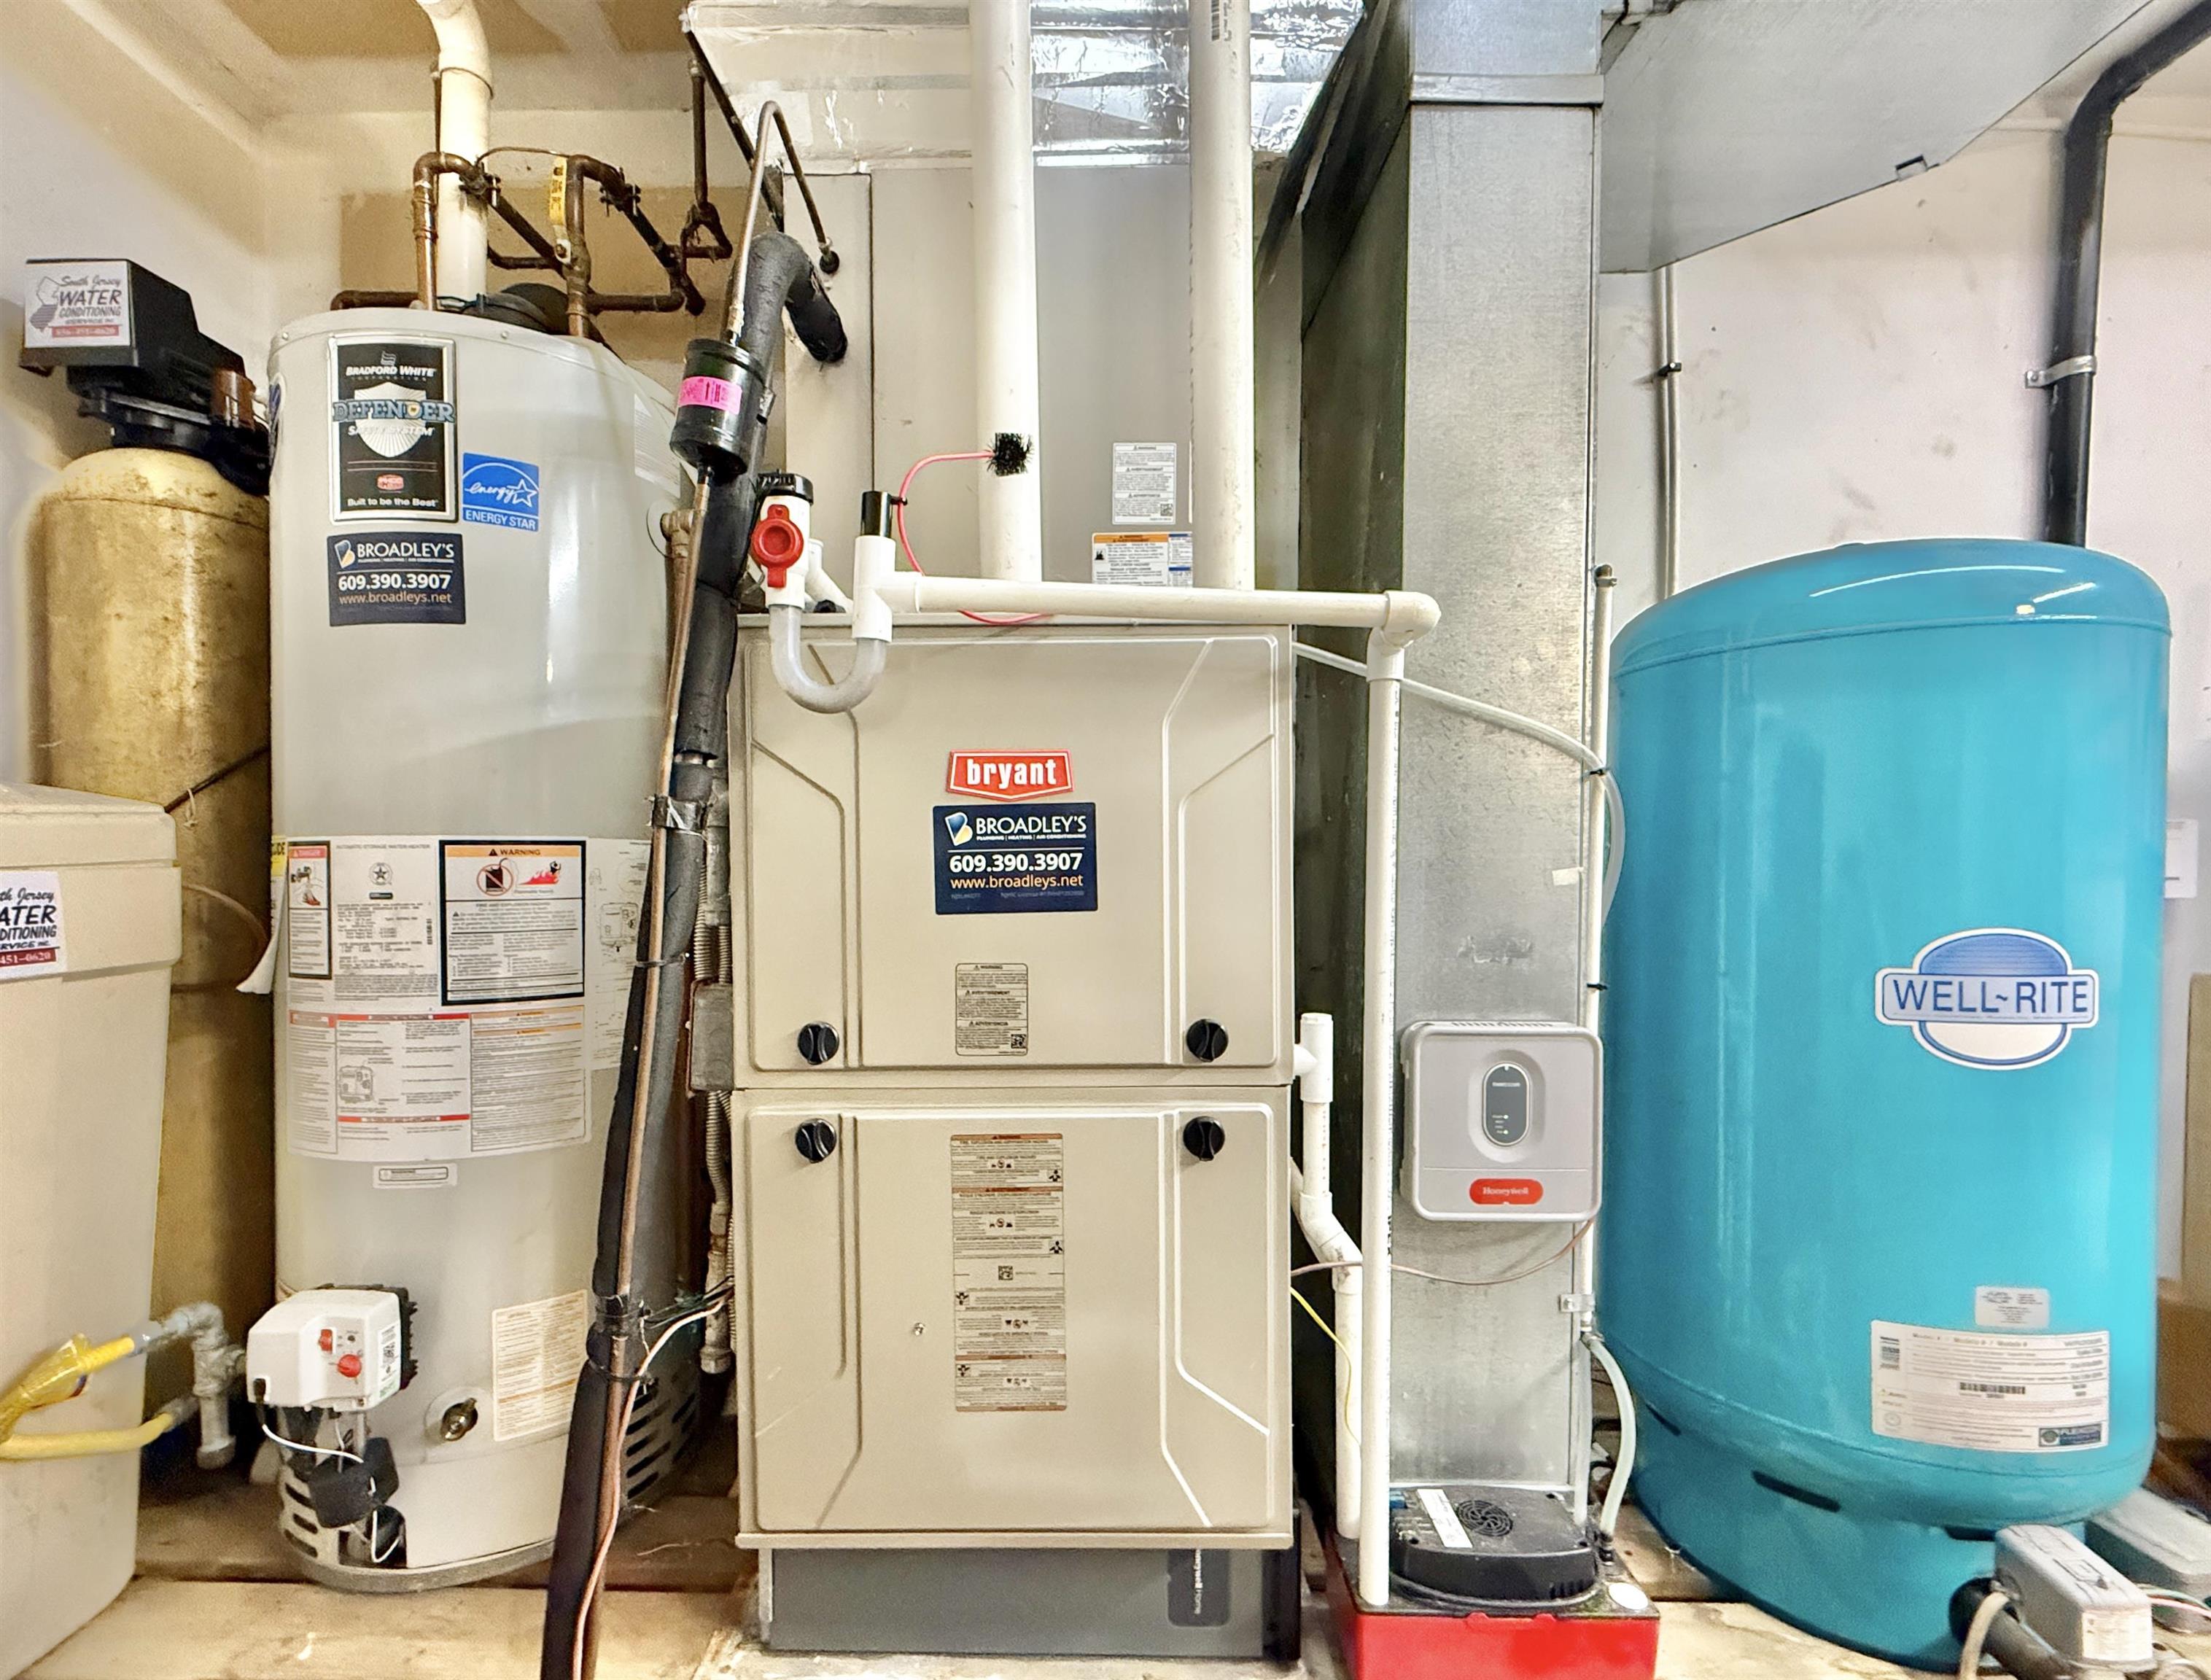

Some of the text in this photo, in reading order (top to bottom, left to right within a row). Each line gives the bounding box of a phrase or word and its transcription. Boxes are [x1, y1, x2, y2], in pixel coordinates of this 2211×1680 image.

[59, 289, 123, 306] WATER
[59, 306, 122, 319] CONDITIONING
[346, 366, 435, 377] BRADFORD WHITE
[333, 400, 455, 423] DEFENDER
[347, 497, 436, 507] Built to be the Best
[465, 511, 536, 531] ENERGY STAR
[357, 542, 455, 559] BROADLEY'S
[338, 573, 451, 591] 609.390.3907
[339, 591, 452, 605] www.broadleys.net
[967, 758, 1057, 790] bryant
[976, 815, 1087, 835] BROADLEY'S
[949, 852, 1083, 873] 609.390.3907
[950, 874, 1084, 890] www.broadleys.net
[18, 887, 55, 905] Jersey
[0, 905, 57, 926] ATER
[0, 925, 57, 941] DITIONING
[0, 941, 36, 949] RVICE
[0, 952, 52, 965] 451-0620
[1483, 1186, 1529, 1196] Honeywell
